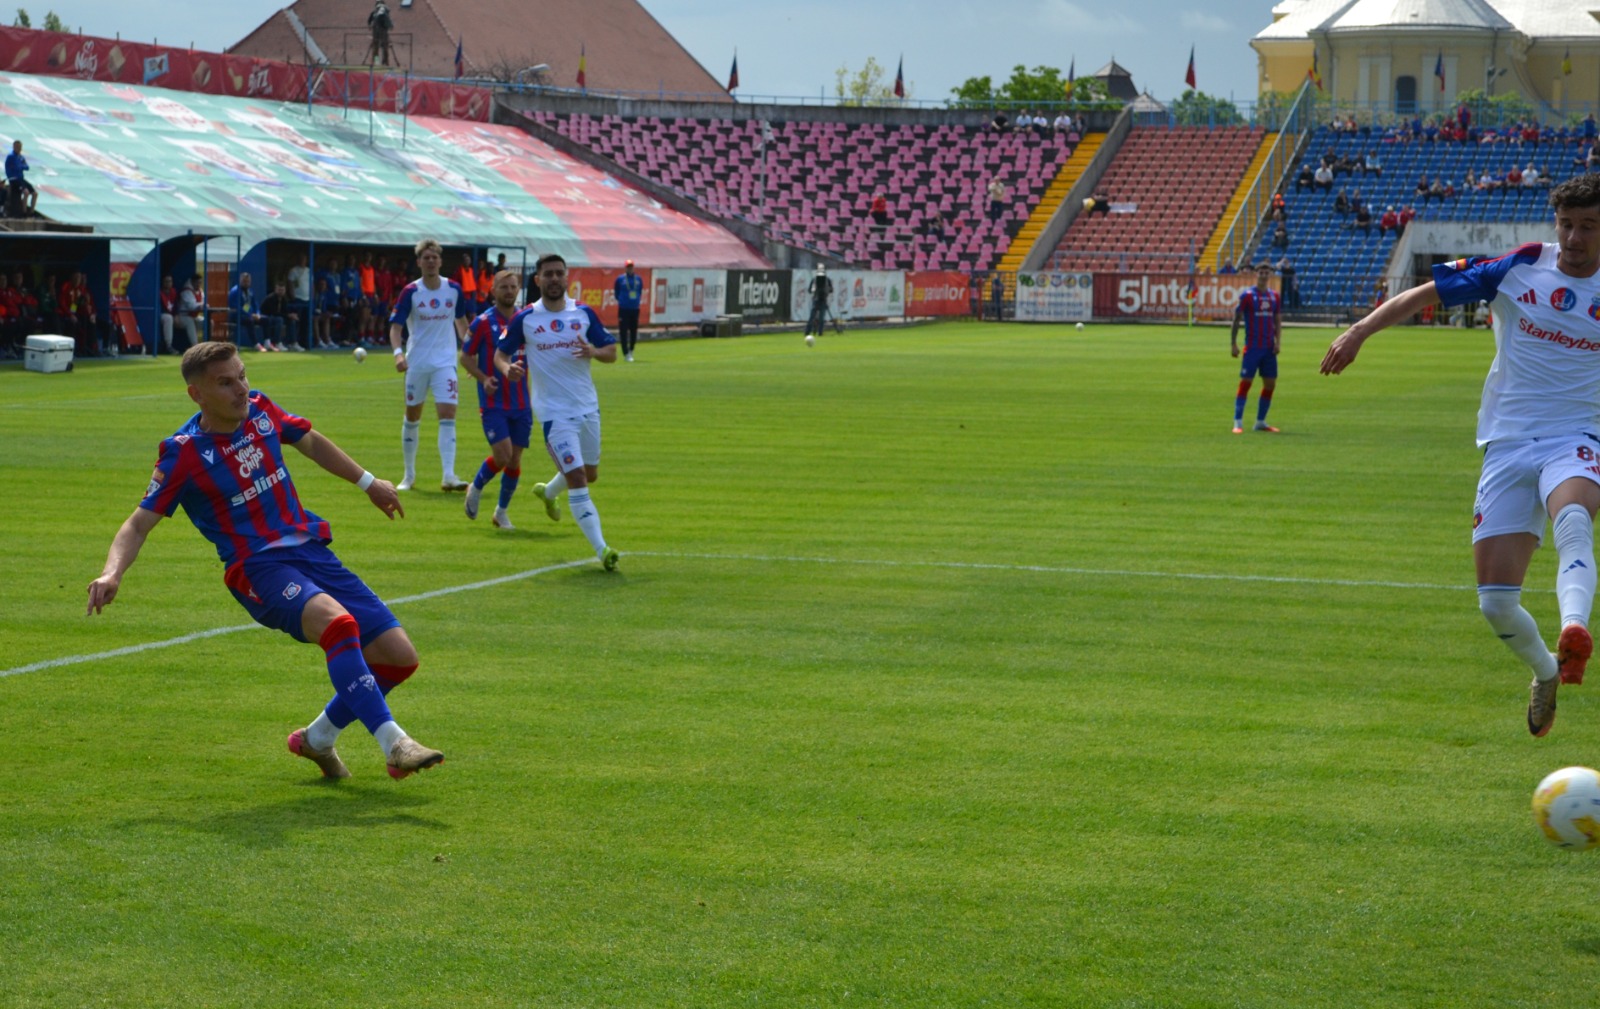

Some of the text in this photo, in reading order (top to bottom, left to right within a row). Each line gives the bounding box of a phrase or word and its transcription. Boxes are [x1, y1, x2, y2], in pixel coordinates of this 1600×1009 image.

[1142, 275, 1248, 306] Interio
[239, 447, 264, 479] Chips
[230, 466, 287, 507] selina
